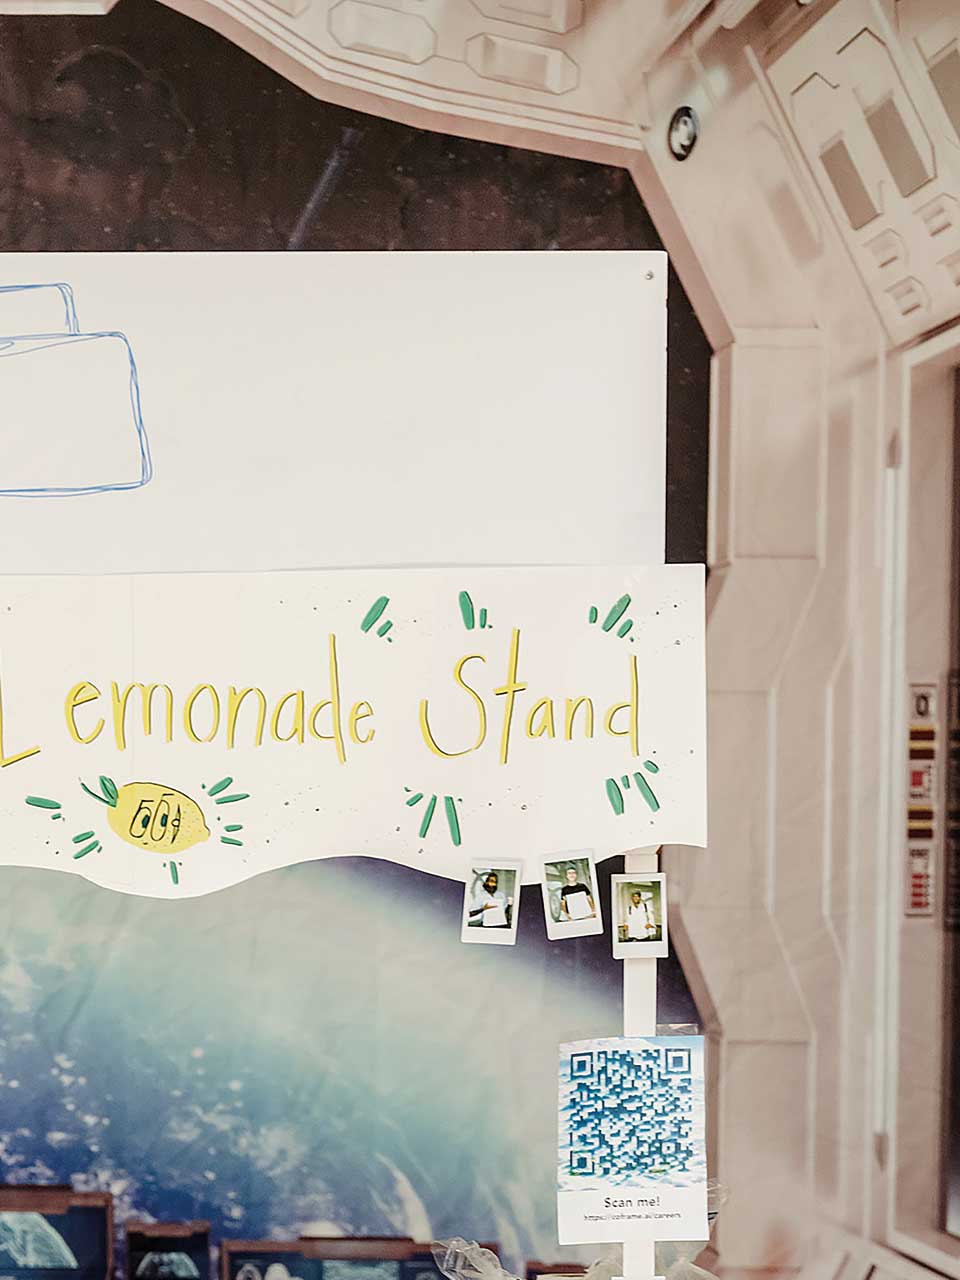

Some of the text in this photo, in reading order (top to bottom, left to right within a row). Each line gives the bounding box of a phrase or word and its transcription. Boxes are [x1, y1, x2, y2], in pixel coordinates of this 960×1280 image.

[420, 628, 645, 765] Stand
[604, 1194, 661, 1208] Scan me!
